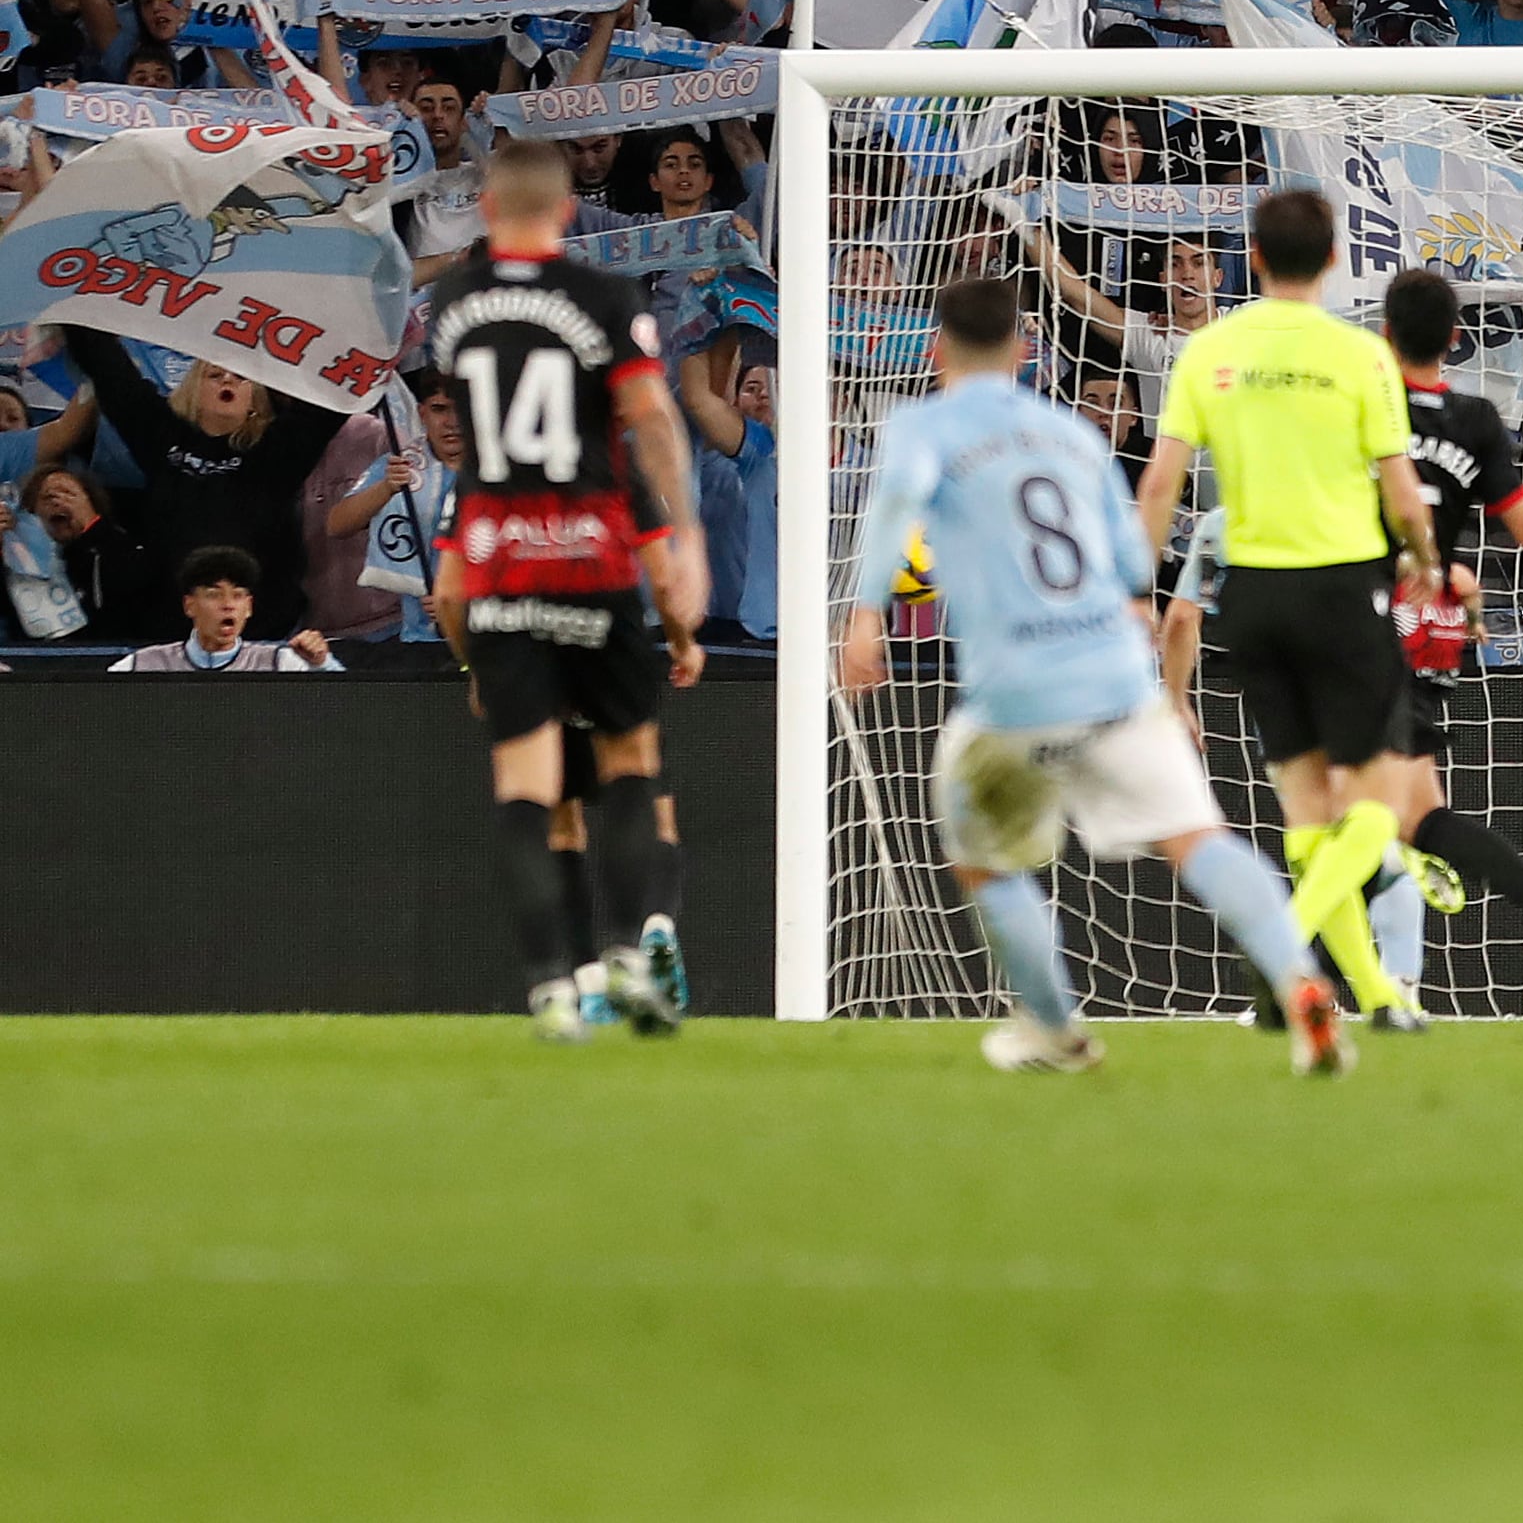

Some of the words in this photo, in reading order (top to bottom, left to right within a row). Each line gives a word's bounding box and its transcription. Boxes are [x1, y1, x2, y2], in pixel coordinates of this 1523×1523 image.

[62, 92, 139, 129] FORA
[517, 85, 607, 125] FORA
[617, 79, 661, 113] DE
[671, 64, 763, 107] XOGO
[452, 342, 585, 488] 14
[1018, 475, 1084, 593] 8
